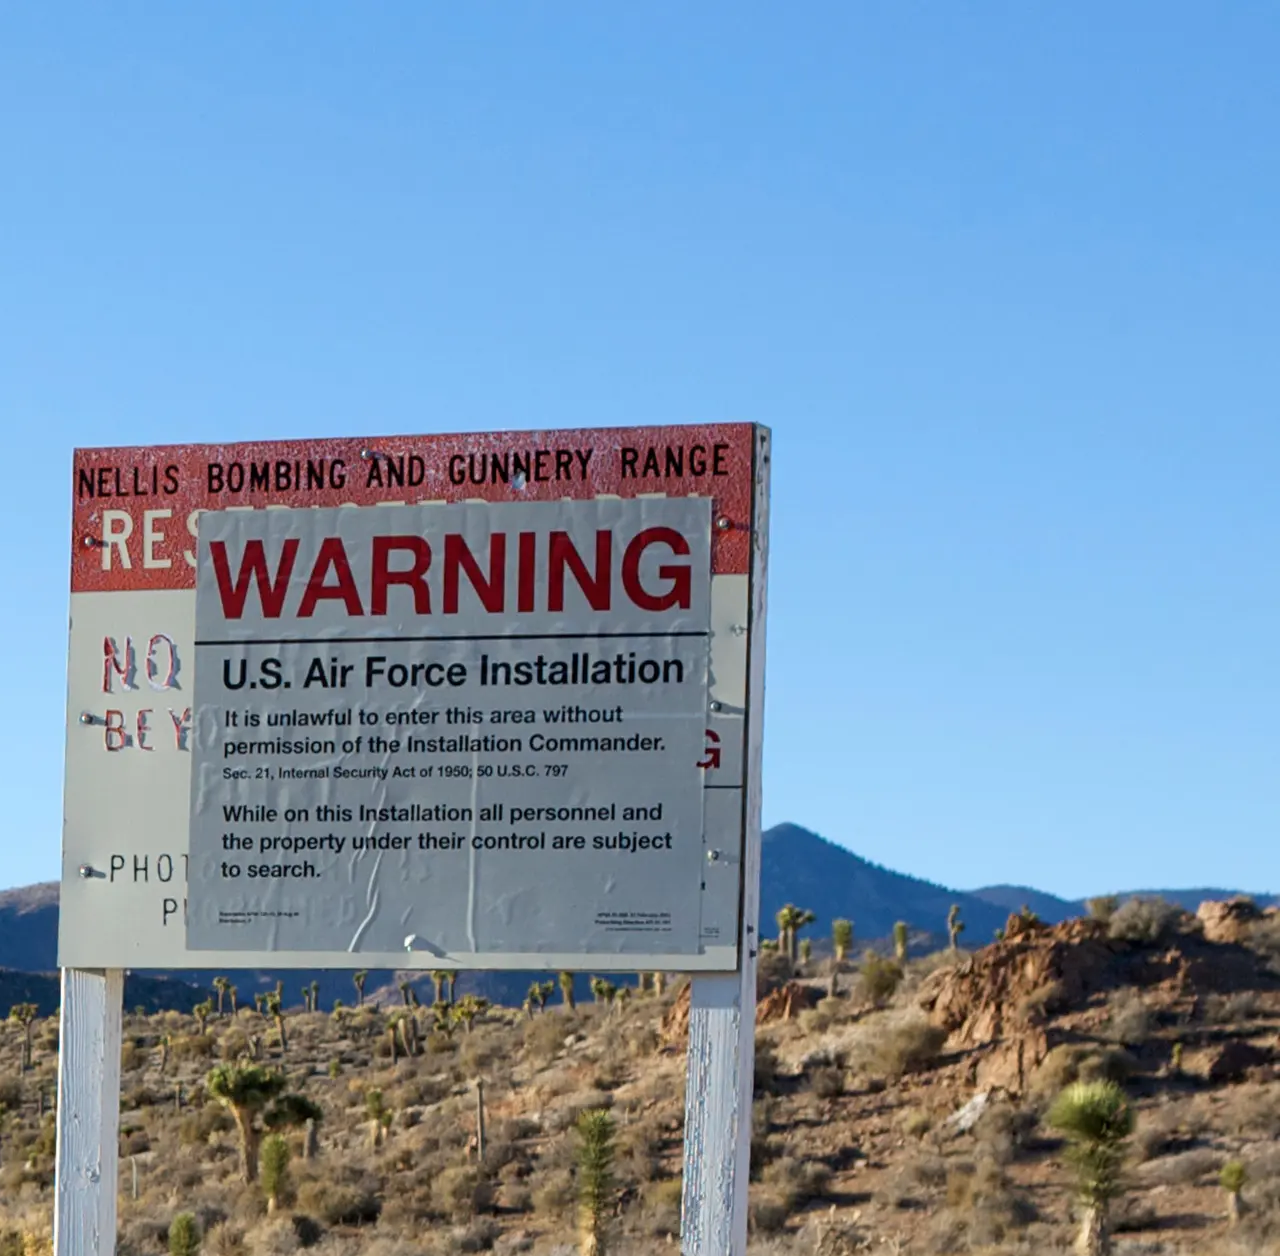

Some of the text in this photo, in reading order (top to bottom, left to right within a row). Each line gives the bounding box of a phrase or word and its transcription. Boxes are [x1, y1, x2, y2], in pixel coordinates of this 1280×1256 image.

[79, 444, 729, 498] NELLIS BOMBING AND GUNNERY RANGE
[210, 527, 691, 618] WARNING
[103, 633, 175, 692] NO
[223, 651, 684, 691] U.S. Air Force Installation
[225, 705, 623, 727] It is unlawful to enter this area without
[224, 733, 665, 759] permission of the Installation Commander.
[222, 764, 569, 781] Sec. 21, Internal Security Act of 1950; 50 U.S.C. 797
[222, 802, 663, 825] While on this Installation all personnel and
[222, 831, 672, 854] the property under their control are subject
[220, 860, 321, 878] to search.
